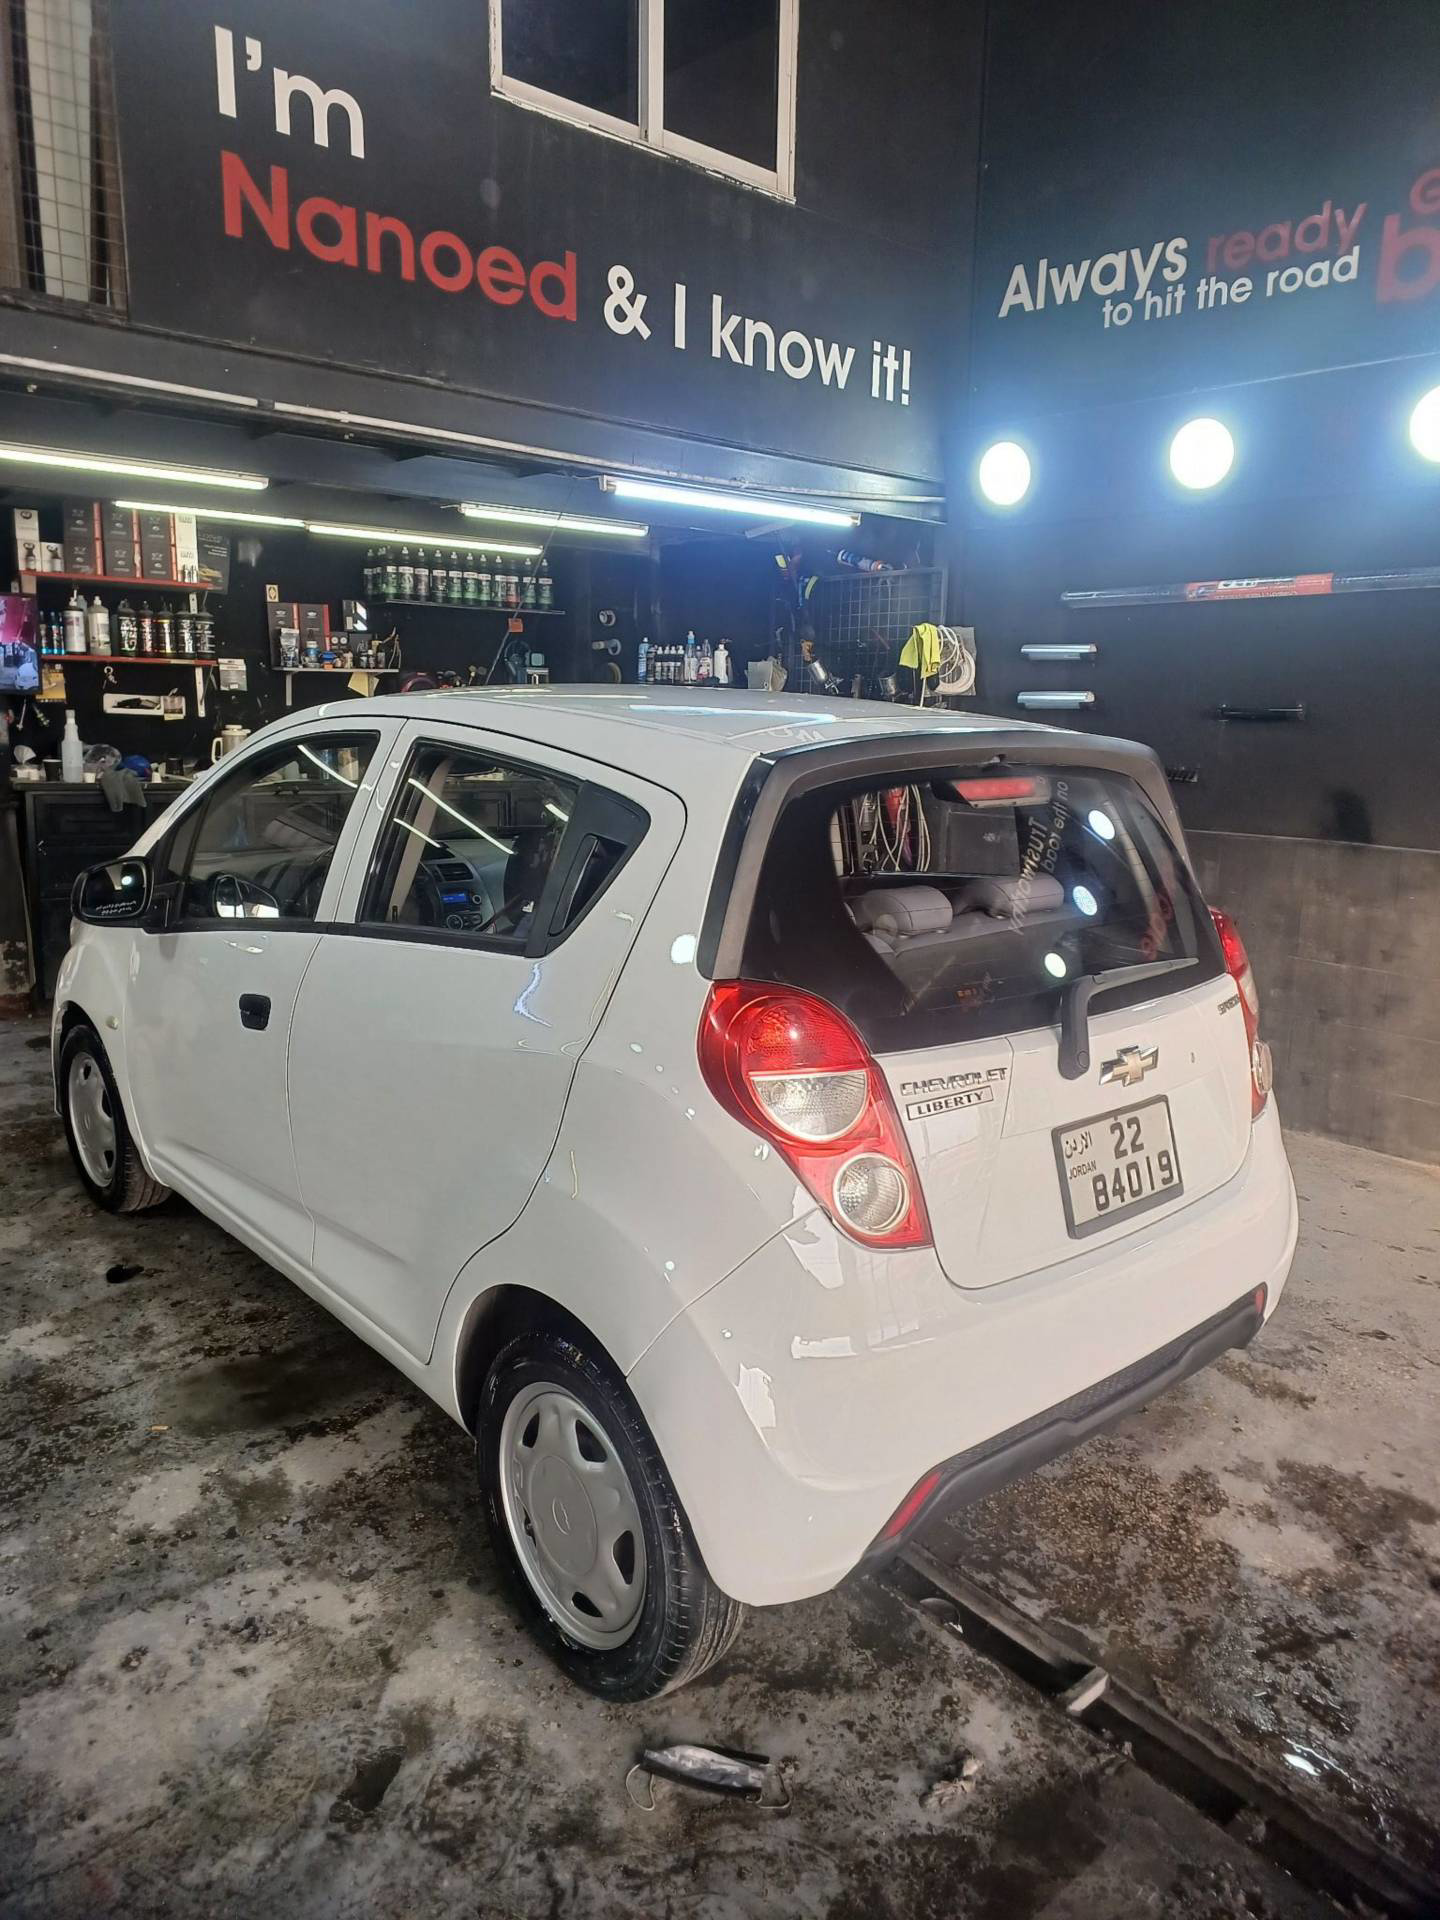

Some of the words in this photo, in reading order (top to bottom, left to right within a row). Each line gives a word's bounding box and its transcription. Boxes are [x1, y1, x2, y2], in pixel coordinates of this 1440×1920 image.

[214, 25, 365, 159] I'm
[220, 149, 578, 322] Nanoed
[603, 264, 652, 341] &
[674, 283, 687, 350] I
[712, 294, 856, 390] know
[872, 340, 911, 405] it!
[998, 236, 1188, 317] Always
[1204, 200, 1368, 272] ready
[1102, 298, 1133, 328] to
[1144, 283, 1187, 321] hit
[1197, 275, 1253, 310] the
[1266, 245, 1360, 296] road
[900, 1067, 1008, 1096] CHEVROLET
[917, 1091, 983, 1115] LIBERTY
[1068, 1159, 1097, 1180] JORDAN
[1109, 1116, 1145, 1160] 22
[1092, 1149, 1175, 1212] 84019
